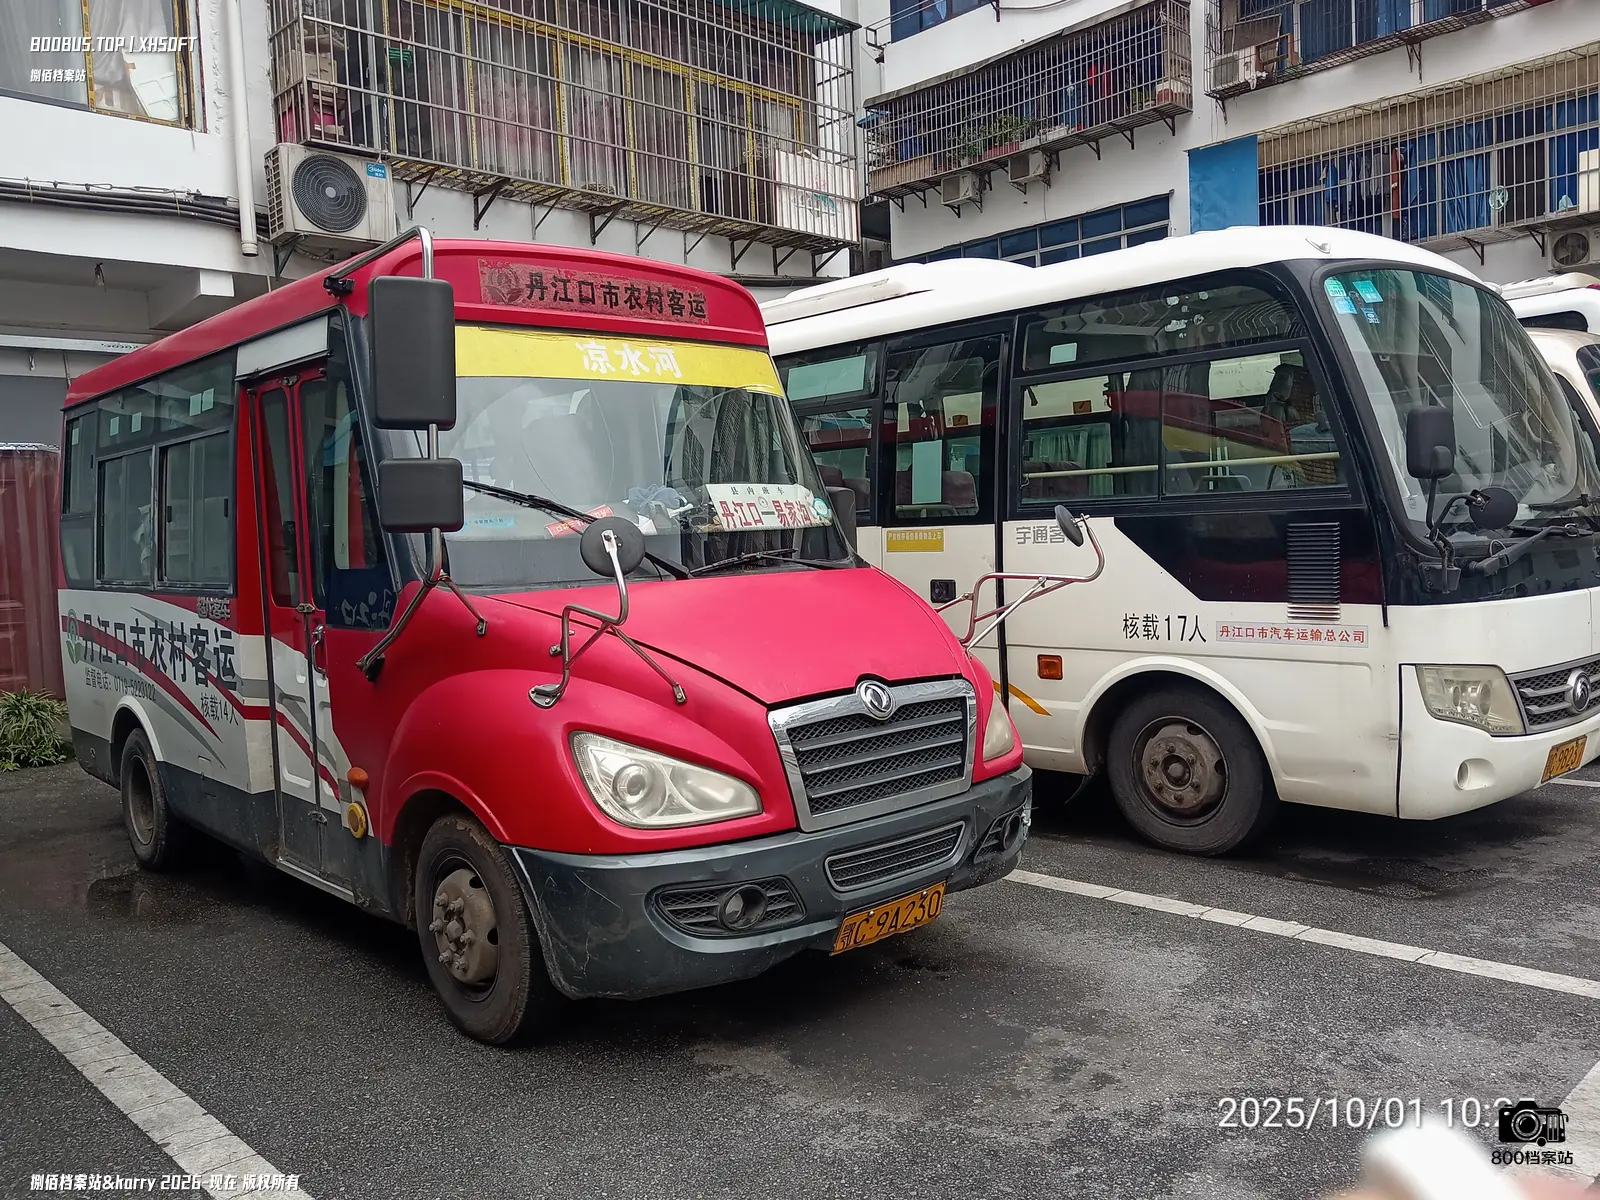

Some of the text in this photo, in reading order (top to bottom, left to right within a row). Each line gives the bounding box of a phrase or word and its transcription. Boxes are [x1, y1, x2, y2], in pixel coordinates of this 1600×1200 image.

[526, 272, 707, 319] 丹江口市农村客运
[575, 340, 683, 379] 凉水河
[1016, 525, 1069, 545] 宇通客
[1122, 612, 1207, 643] 核载17人
[1219, 625, 1365, 644] 丹江口市汽车运输总公司
[82, 613, 238, 691] 丹江口市农村客运
[200, 692, 239, 726] 核载14人
